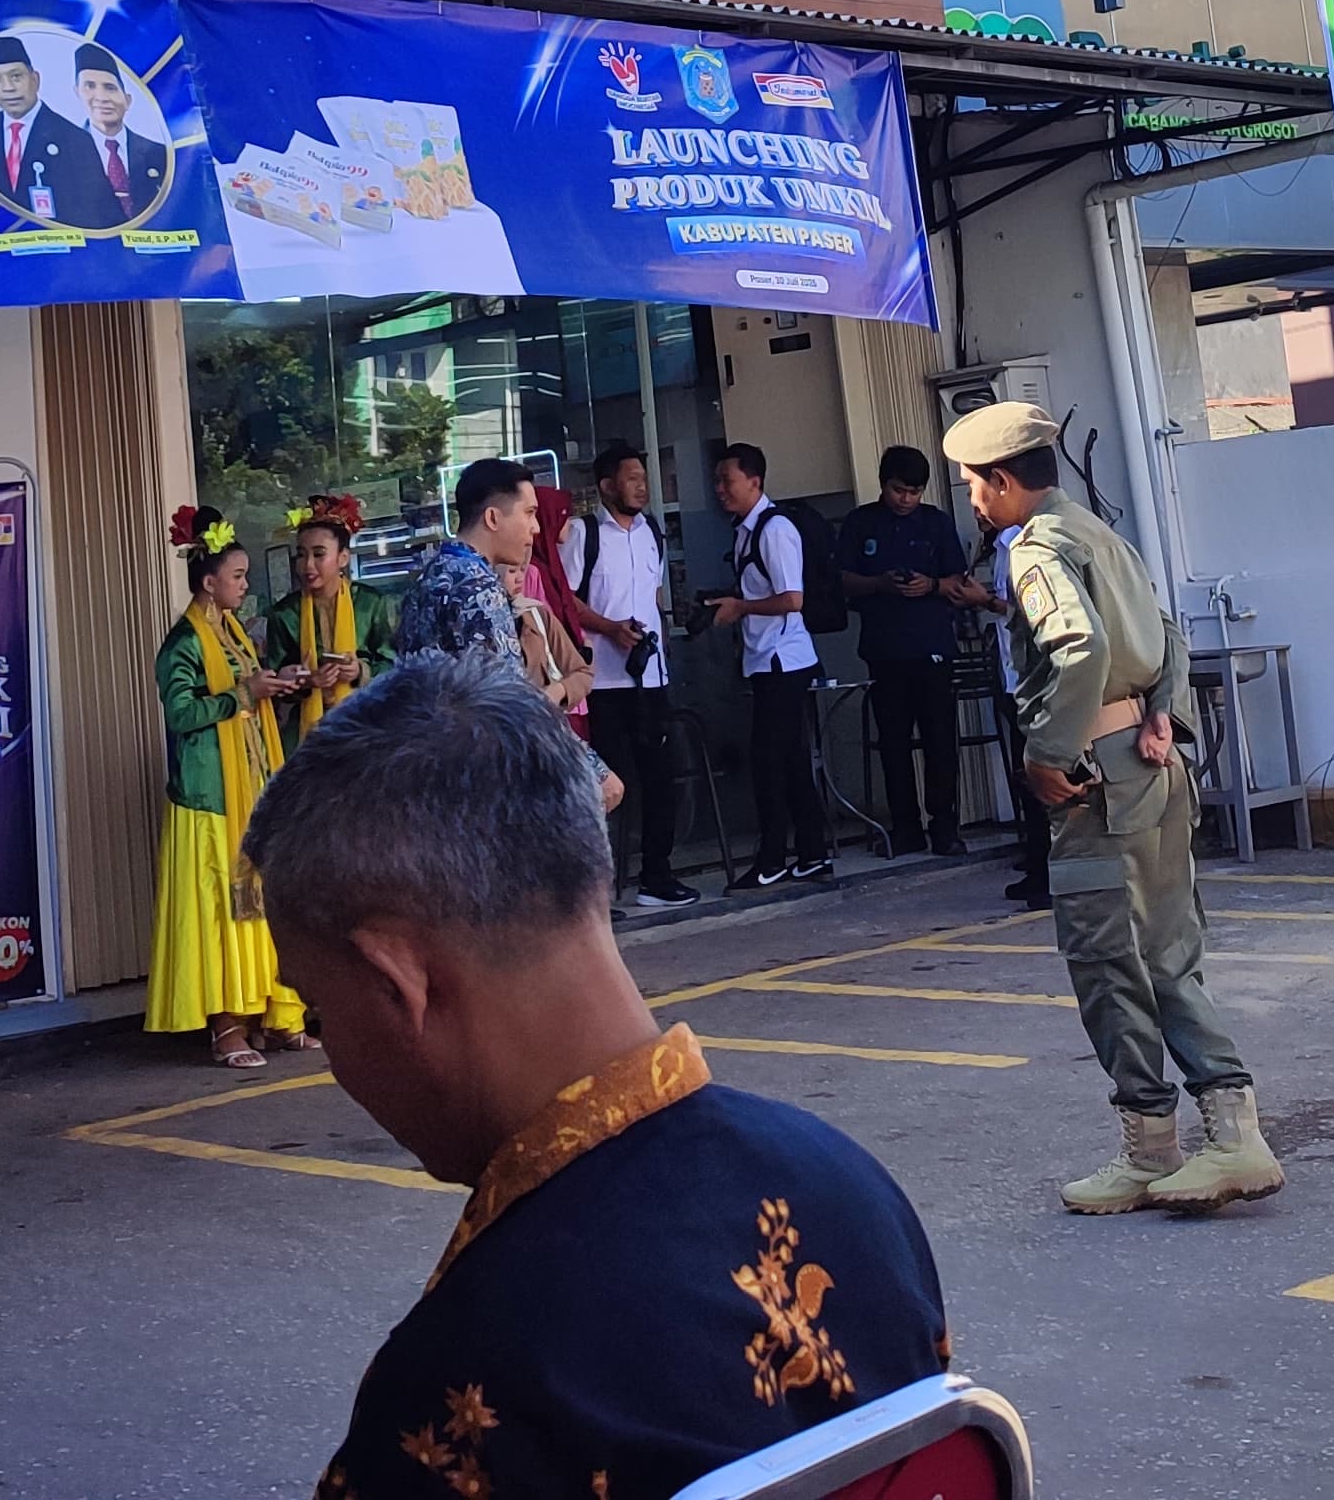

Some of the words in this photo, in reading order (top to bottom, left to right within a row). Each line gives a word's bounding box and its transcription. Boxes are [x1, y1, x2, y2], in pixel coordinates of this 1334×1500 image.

[1242, 122, 1299, 139] GROGOT
[610, 128, 870, 180] LAUNCHING
[610, 173, 774, 210] PRODUK
[770, 176, 893, 232] UMKM
[677, 221, 796, 245] KABUPATEN
[798, 229, 856, 255] PASER
